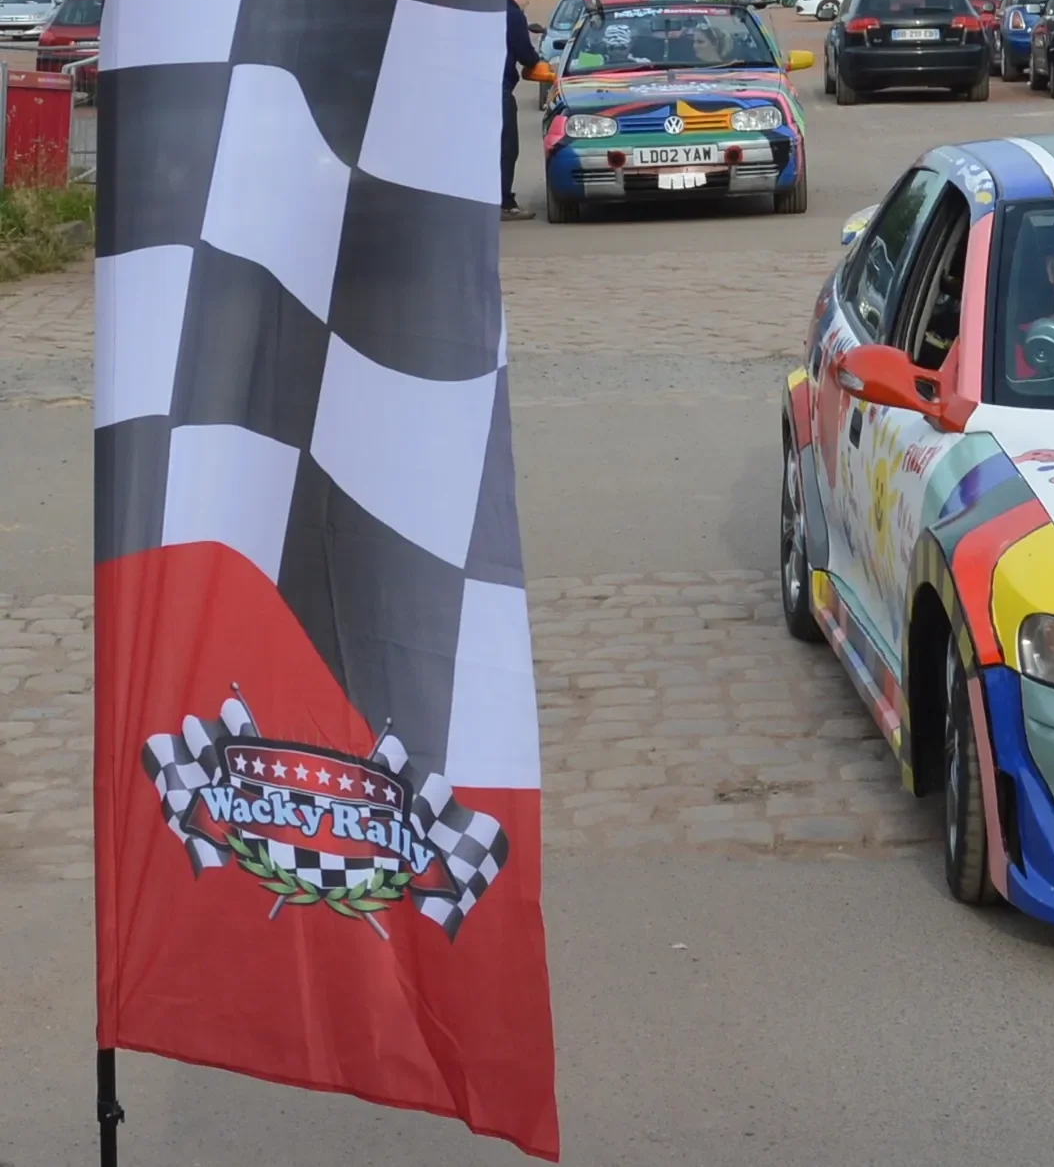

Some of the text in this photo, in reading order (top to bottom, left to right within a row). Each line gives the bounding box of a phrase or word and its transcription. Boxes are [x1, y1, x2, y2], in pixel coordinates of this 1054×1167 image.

[640, 146, 712, 164] LD02 YAW
[199, 786, 436, 875] Wacky Rally
